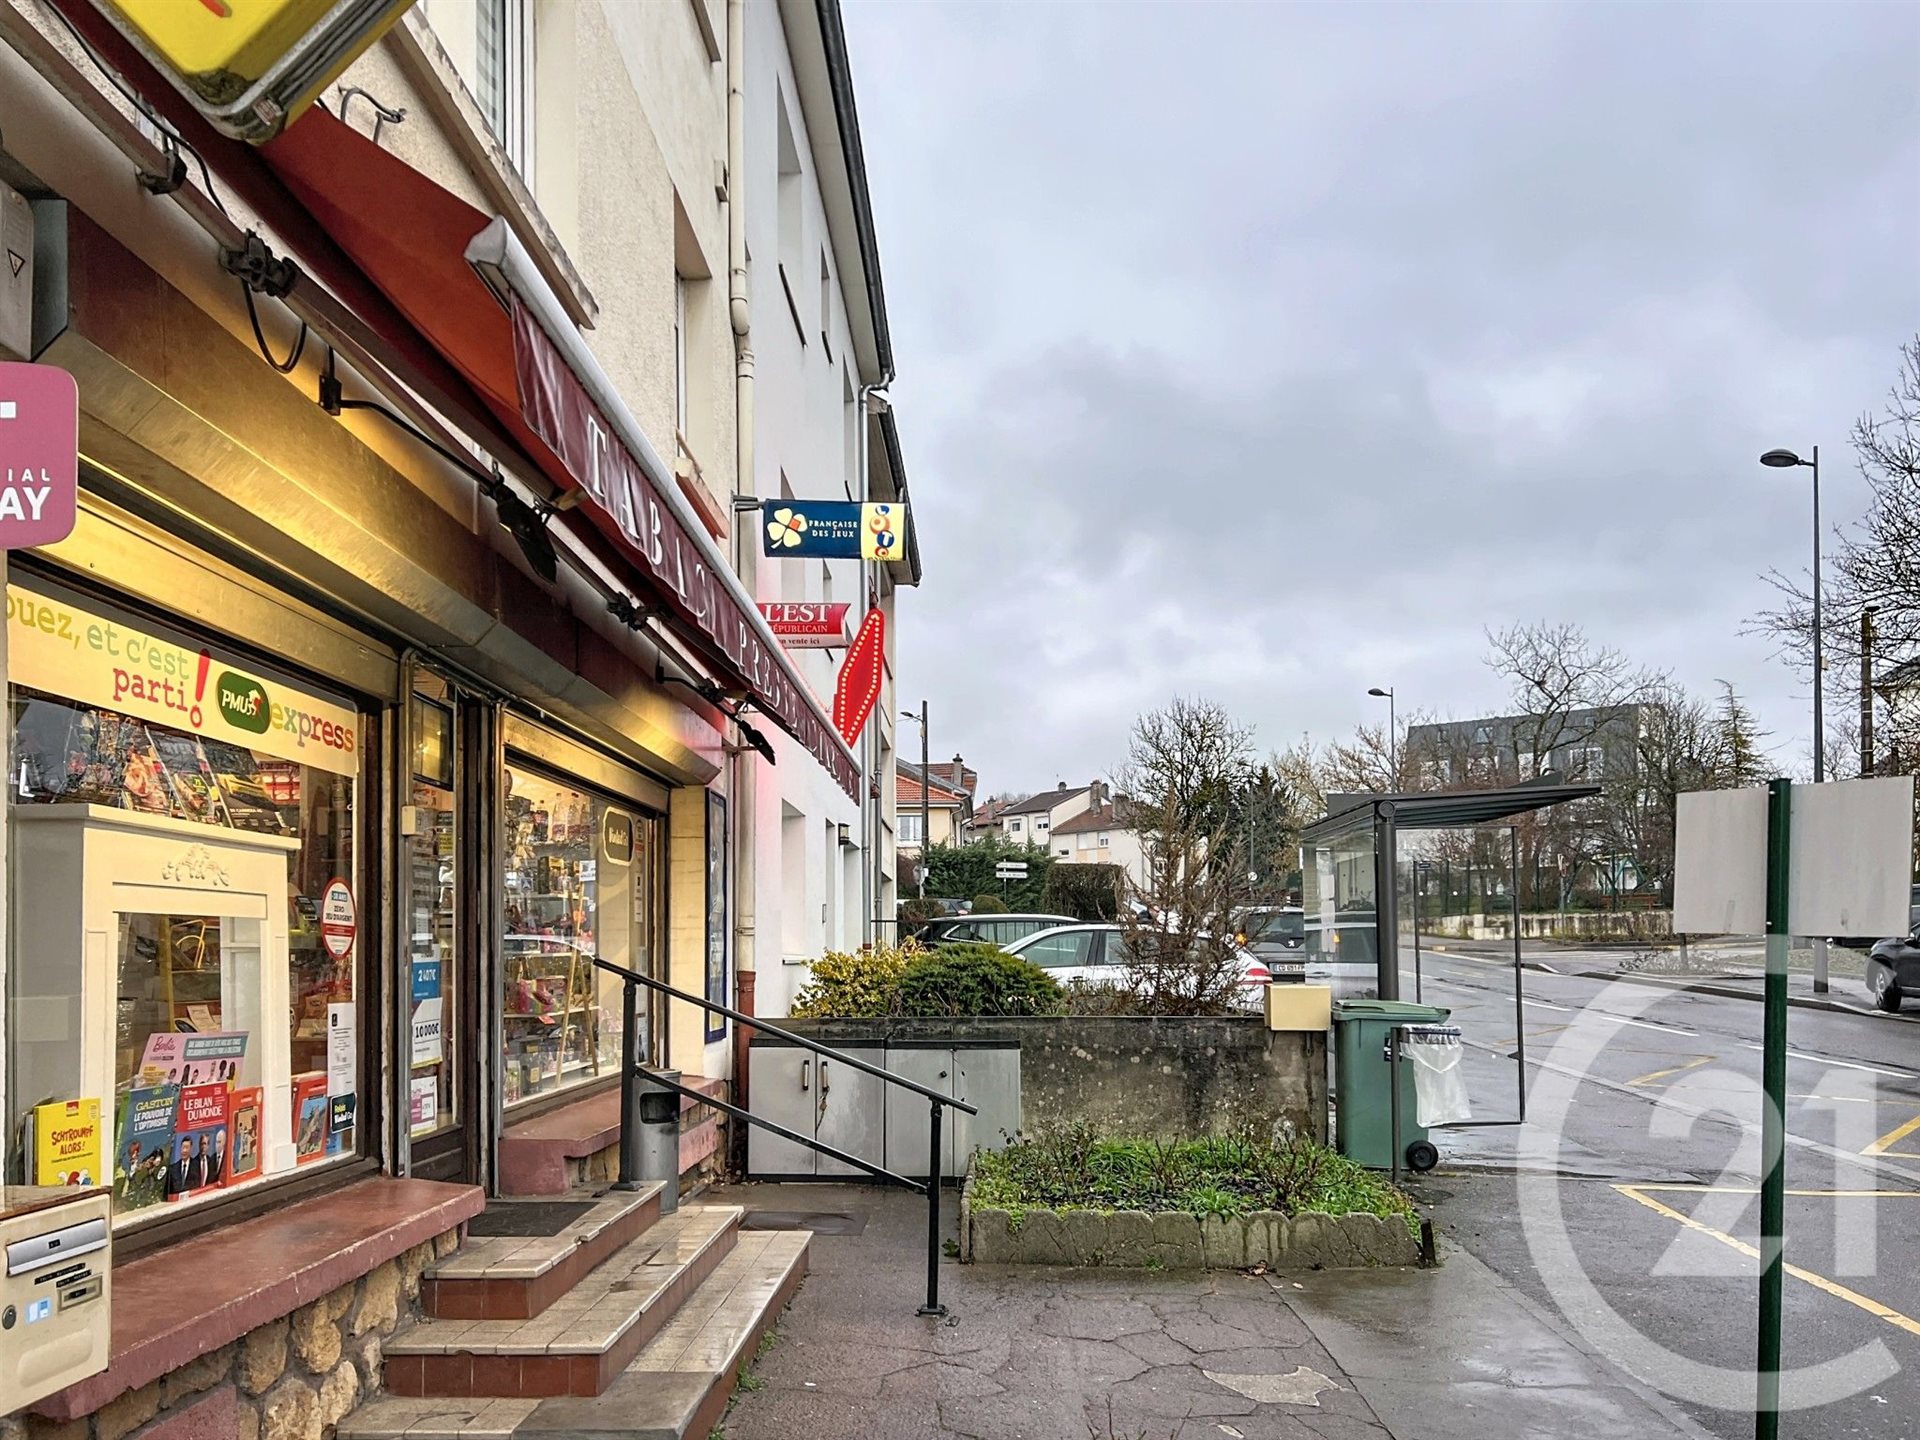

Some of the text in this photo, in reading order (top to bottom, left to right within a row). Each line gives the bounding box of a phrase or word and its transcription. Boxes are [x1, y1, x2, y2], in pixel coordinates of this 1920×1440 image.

[808, 519, 858, 531] FRANÇAISE
[812, 529, 855, 538] DES JEUX
[587, 413, 798, 728] TABAC PRESSE
[764, 604, 832, 623] L'EST
[6, 592, 190, 680] ouez, et c'est
[810, 637, 820, 645] ici
[221, 688, 354, 753] PMU express
[135, 1097, 175, 1112] GASTON
[183, 1096, 213, 1111] LE BILAN
[141, 1109, 165, 1120] POUVOIR
[187, 1106, 223, 1121] DU MONDE
